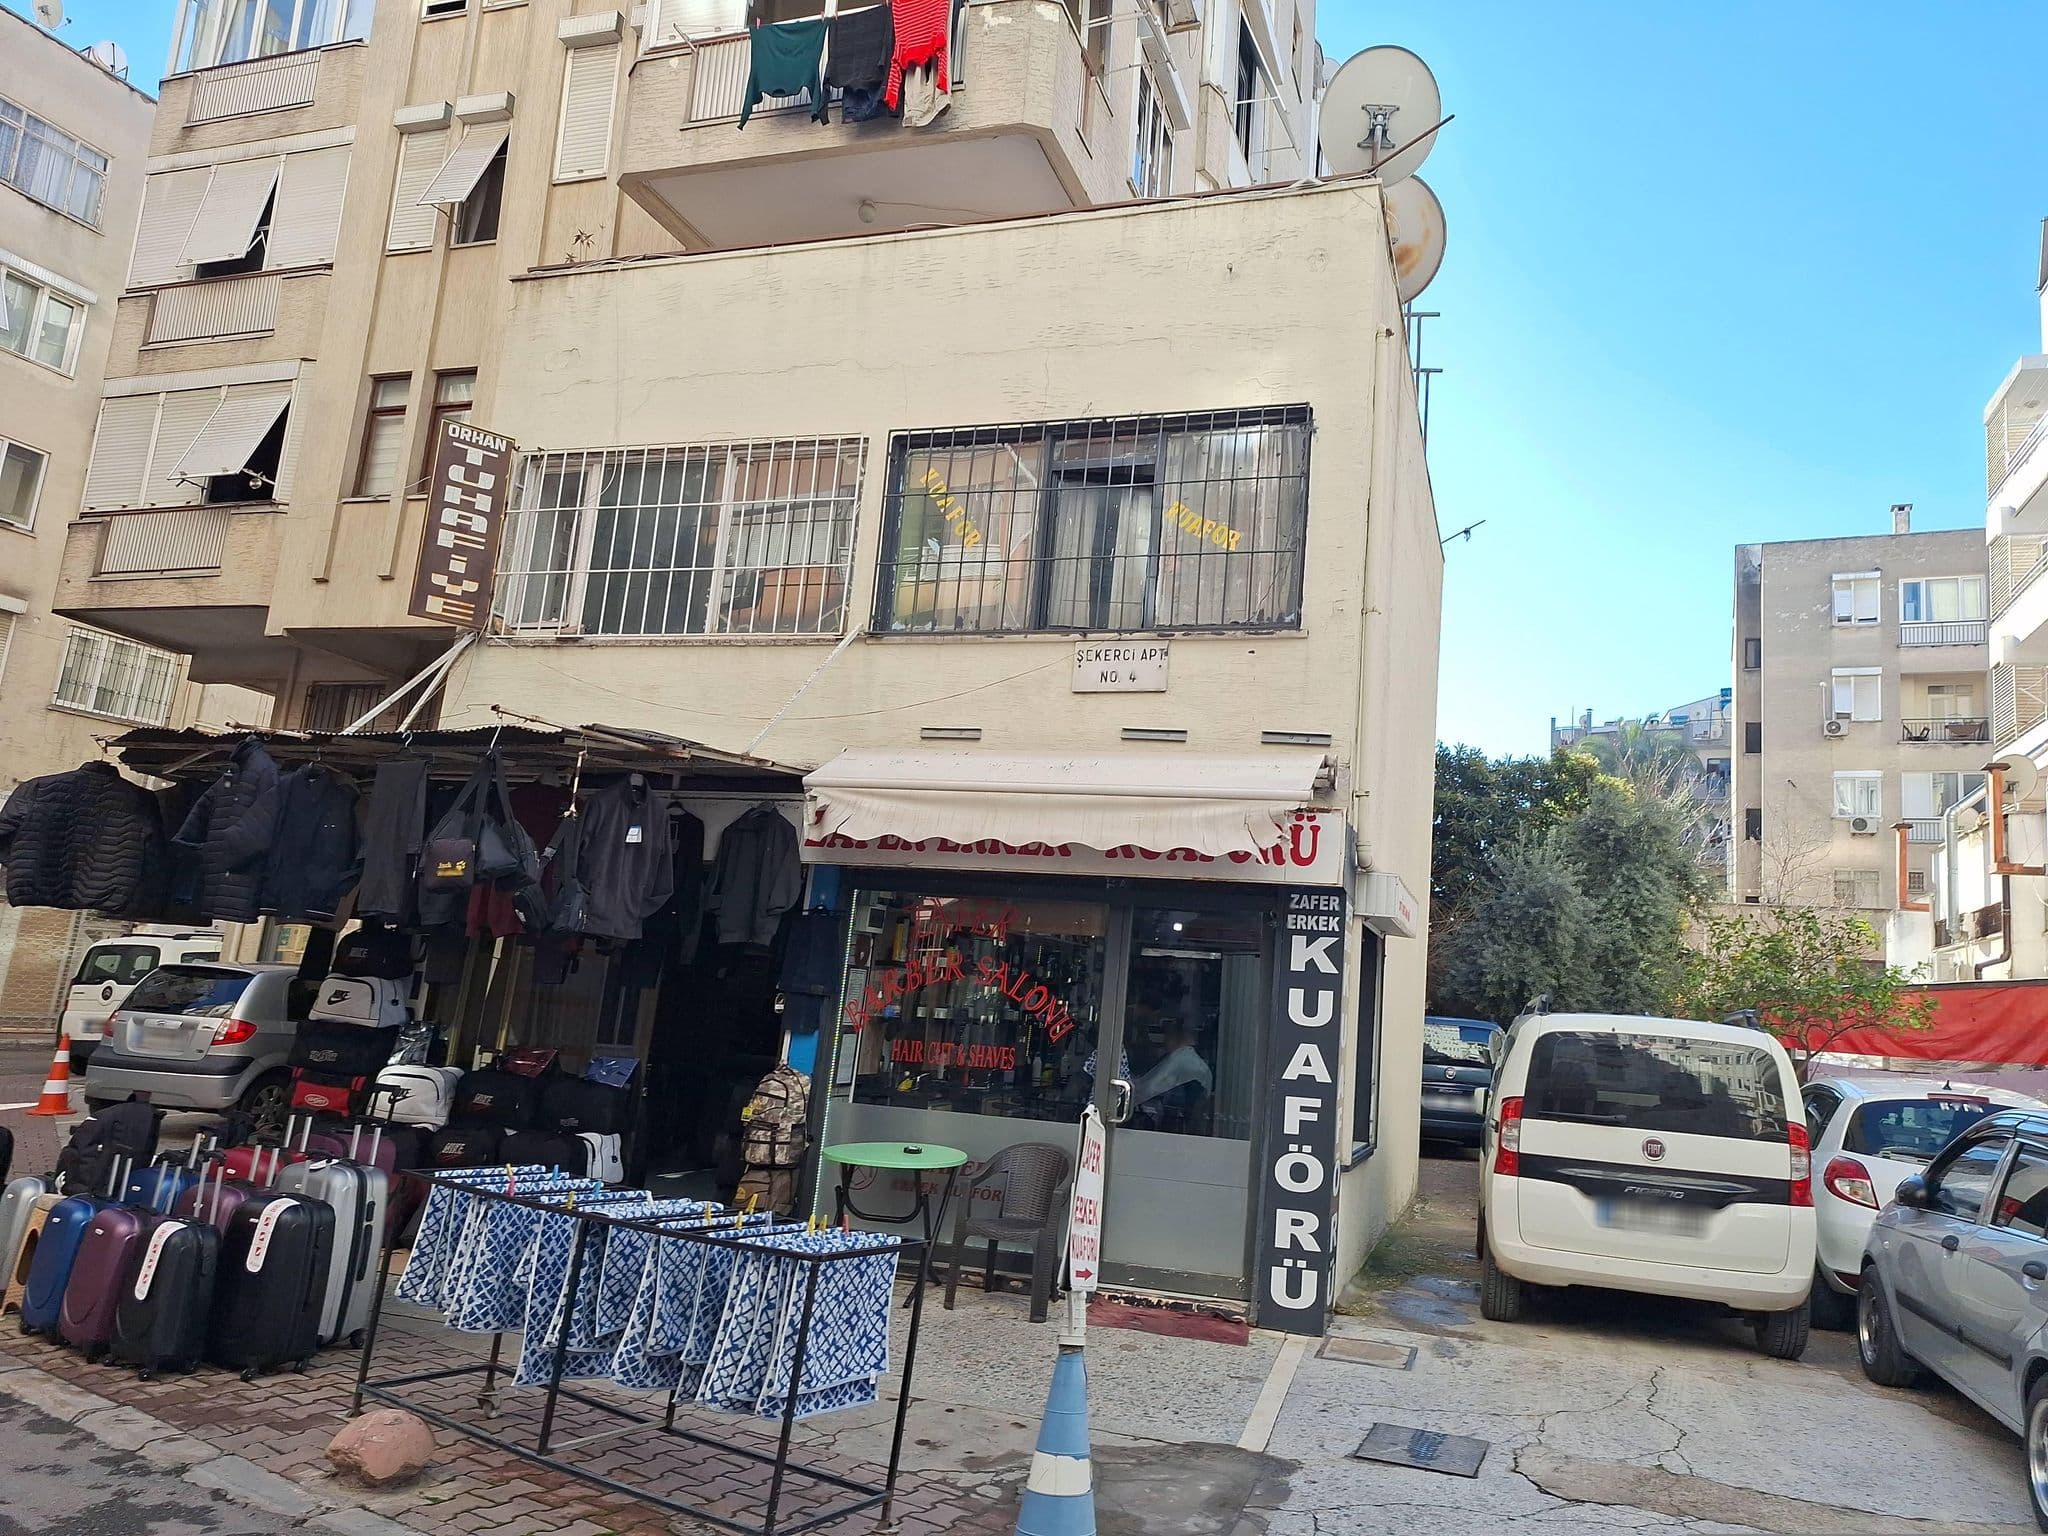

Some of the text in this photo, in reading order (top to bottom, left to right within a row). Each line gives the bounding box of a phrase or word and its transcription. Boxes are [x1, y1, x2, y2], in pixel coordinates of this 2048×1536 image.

[448, 423, 507, 452] ORHAN
[1129, 671, 1137, 683] 4
[1289, 893, 1341, 912] ZAFER
[1286, 914, 1340, 933] ERKEK
[844, 952, 966, 1035] BARBER
[891, 1039, 924, 1063] HAIR
[927, 1041, 955, 1065] CUT
[967, 1044, 1017, 1071] SHAVES
[1270, 935, 1340, 1311] KUAFÖRÜ
[1647, 1143, 1662, 1156] FIAT
